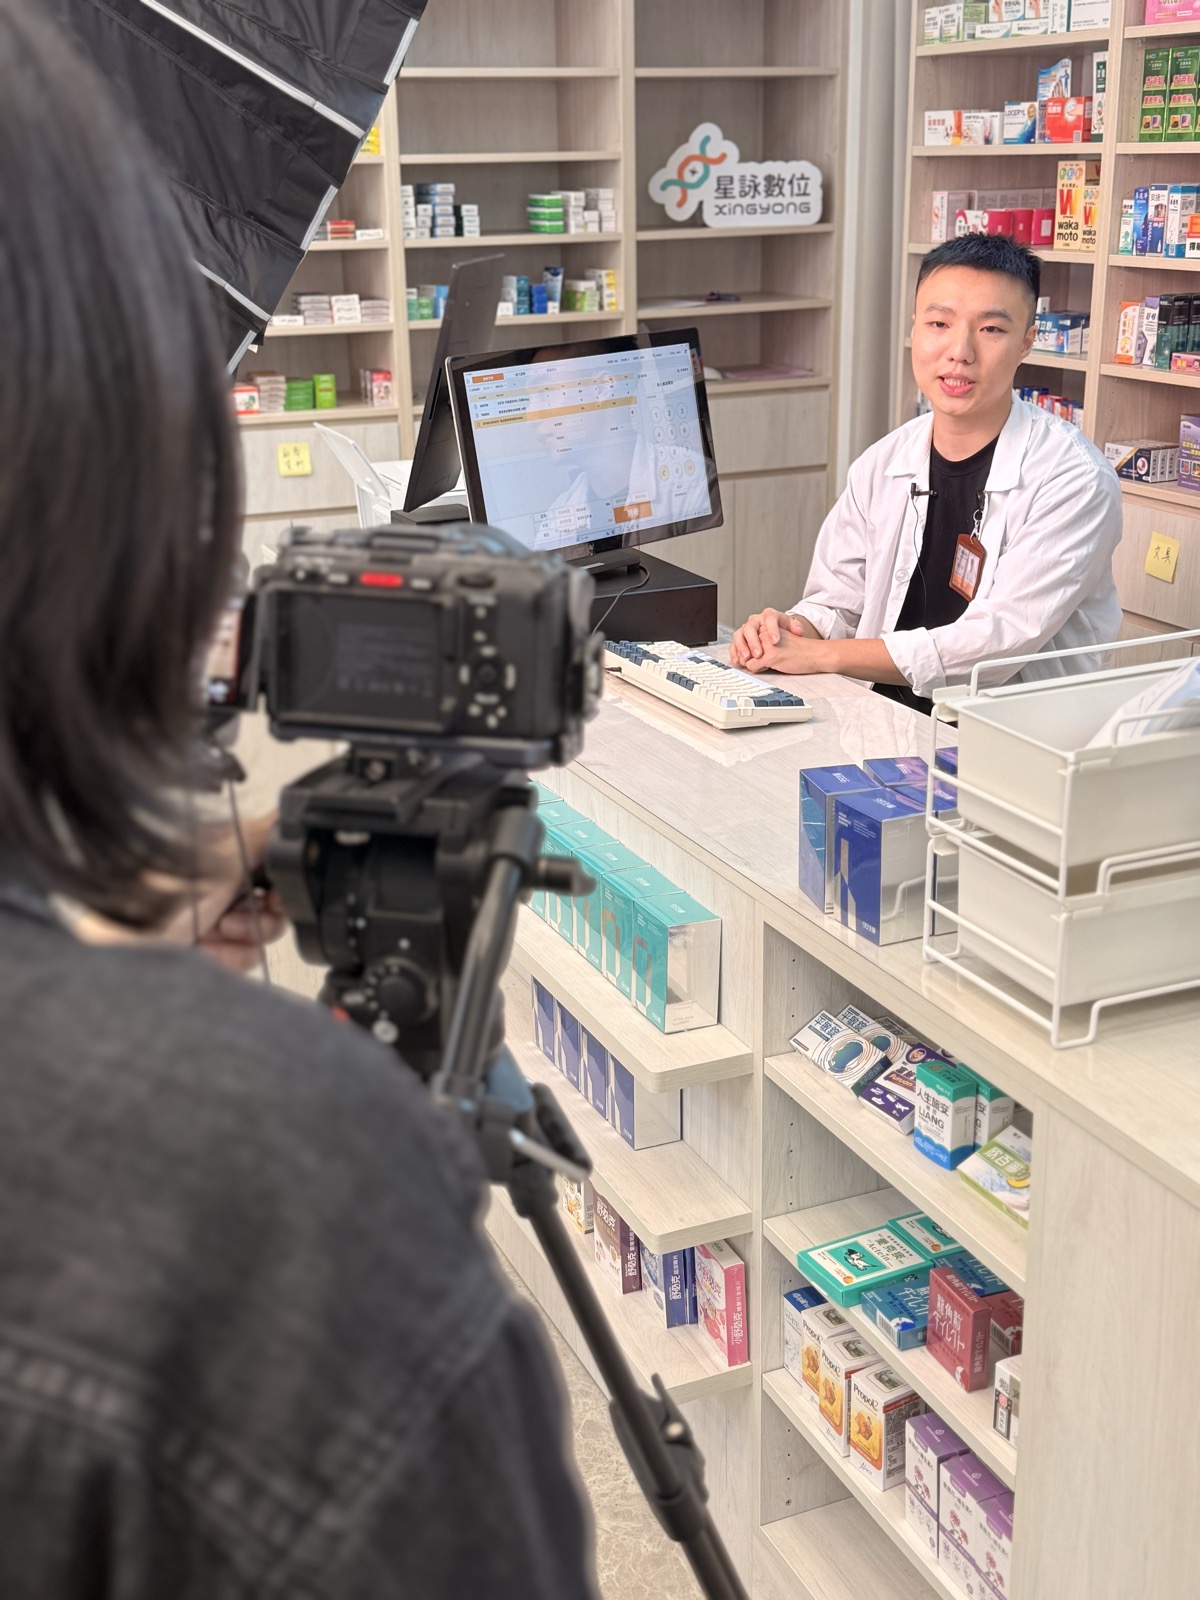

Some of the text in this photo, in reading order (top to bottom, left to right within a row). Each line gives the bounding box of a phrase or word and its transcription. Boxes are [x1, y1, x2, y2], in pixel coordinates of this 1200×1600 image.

[714, 173, 811, 200] 星詠數位
[1056, 231, 1078, 242] moto
[1058, 220, 1079, 230] waka
[1082, 228, 1097, 236] waka
[918, 1106, 944, 1129] LIANG
[867, 1242, 890, 1262] Actein
[672, 1275, 681, 1300] 舒必克
[936, 1293, 963, 1331] 龍角散
[853, 1380, 879, 1409] Propol2
